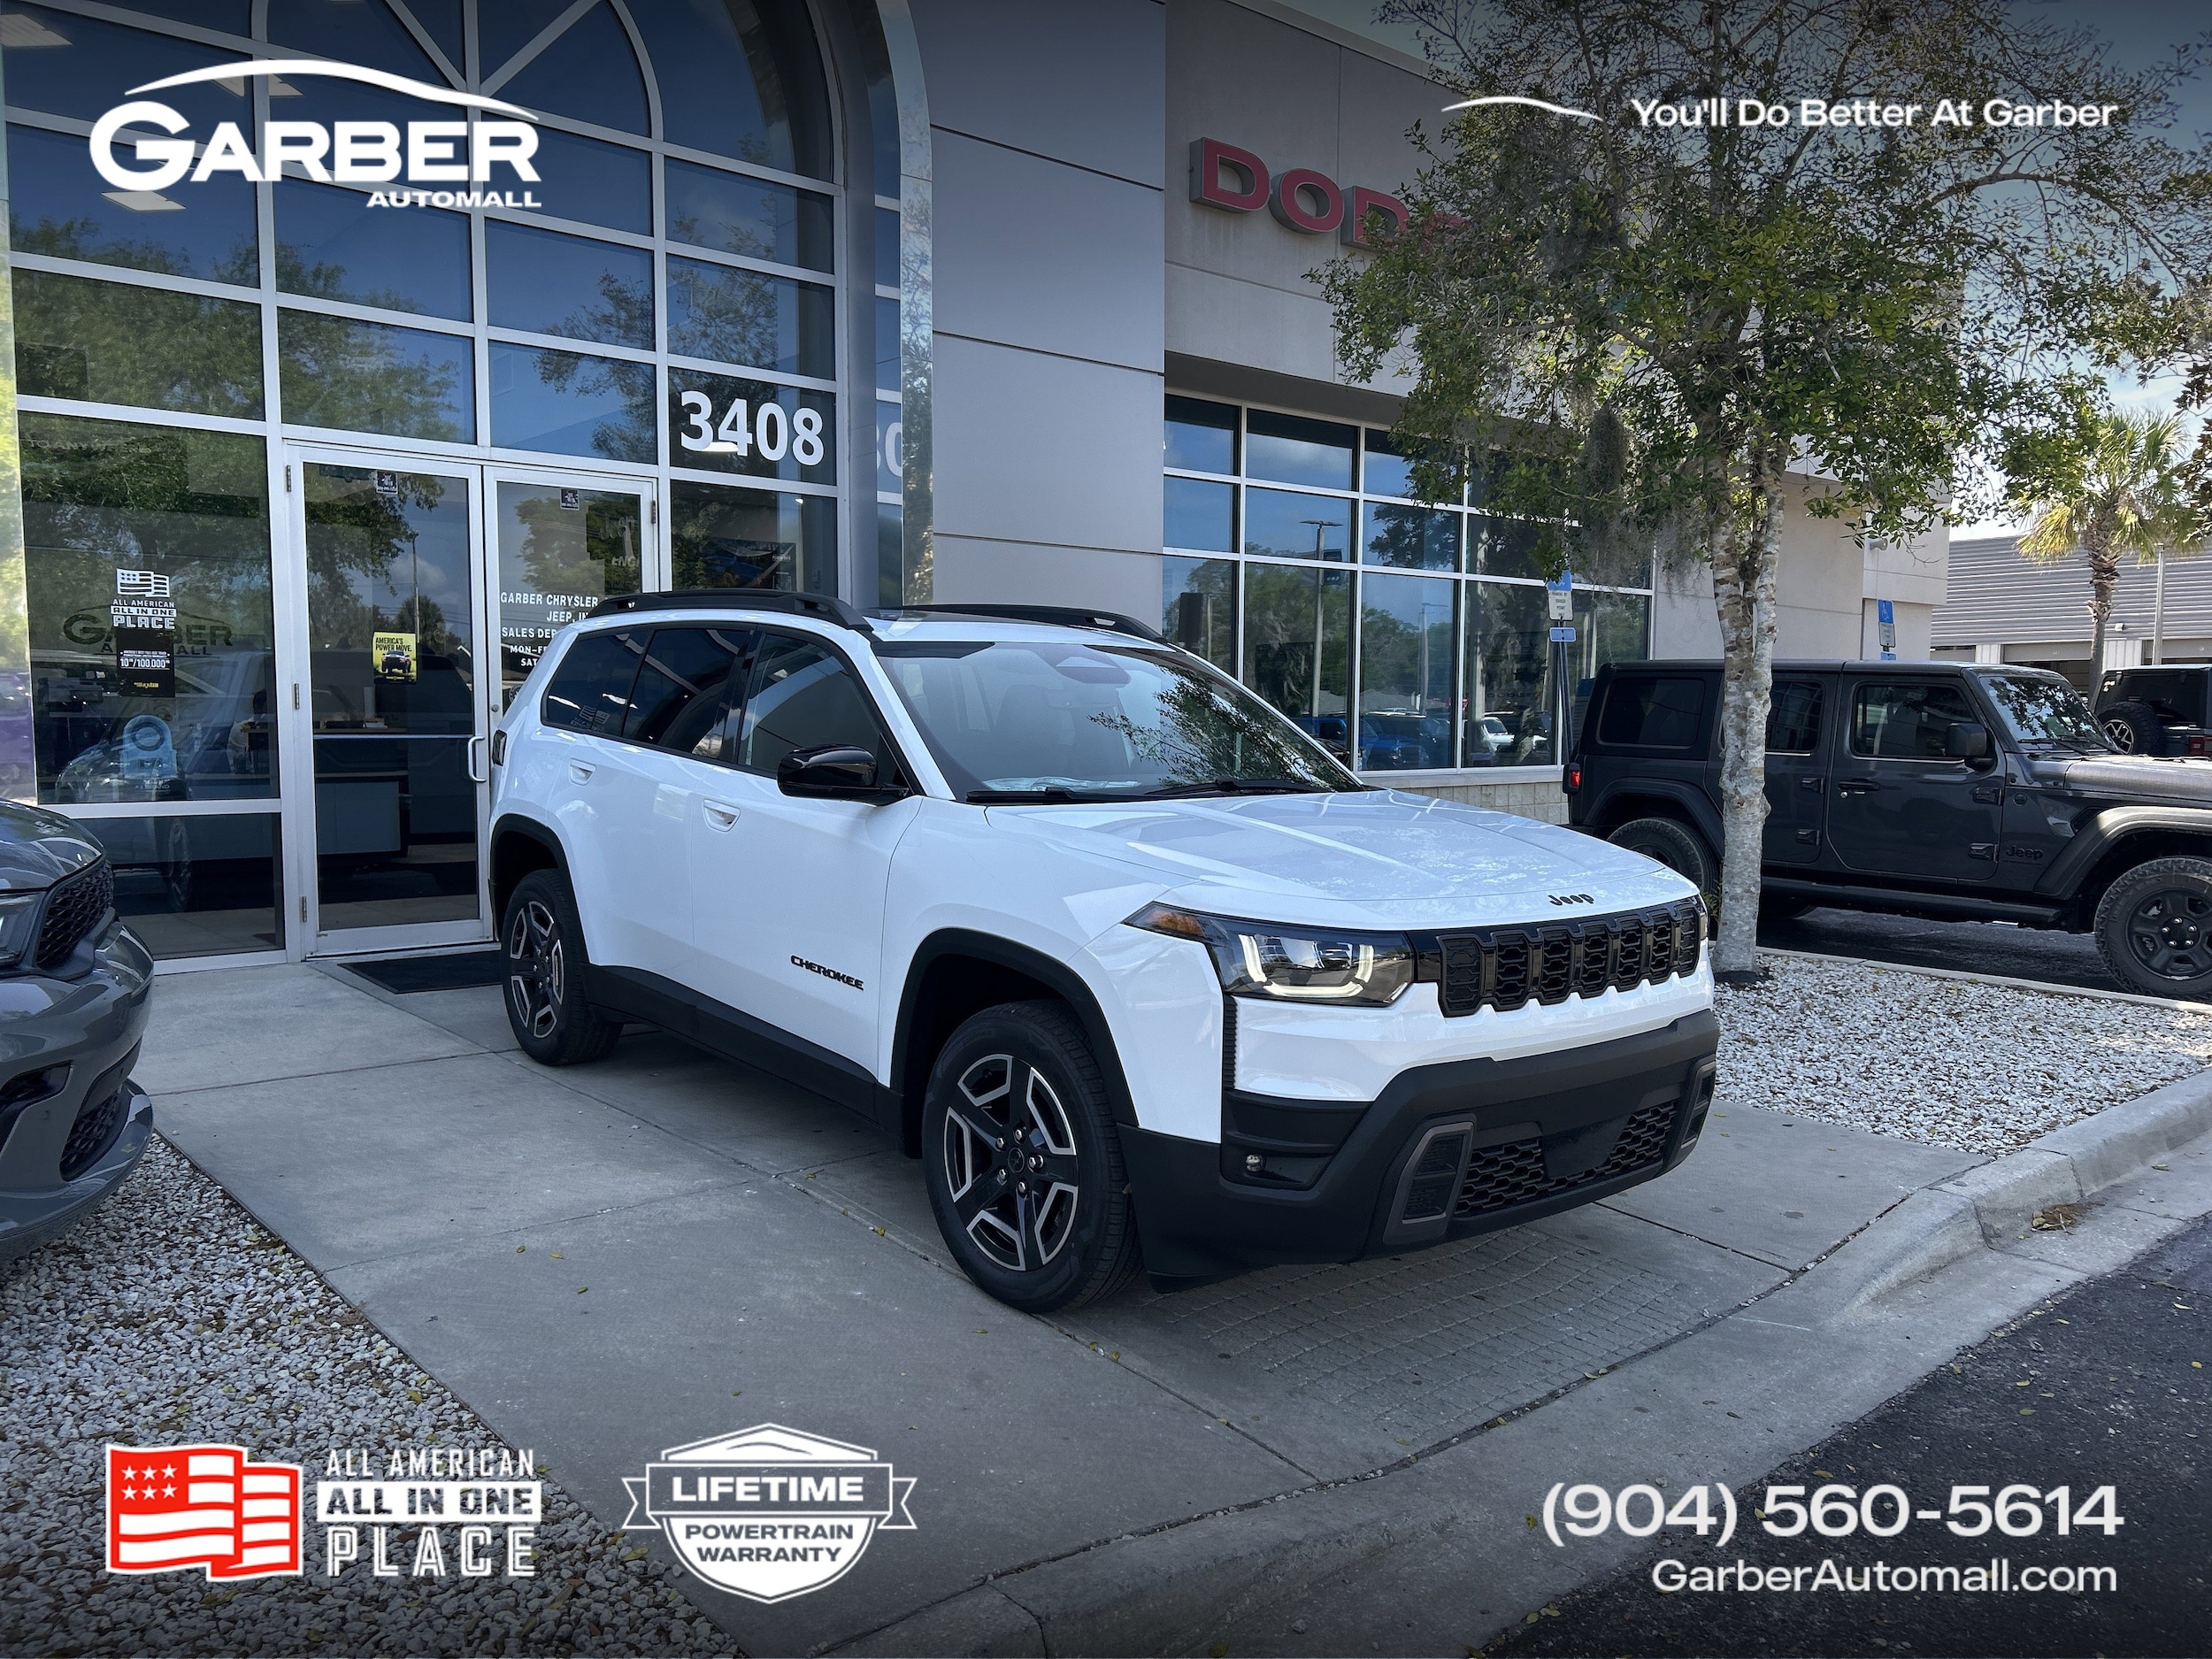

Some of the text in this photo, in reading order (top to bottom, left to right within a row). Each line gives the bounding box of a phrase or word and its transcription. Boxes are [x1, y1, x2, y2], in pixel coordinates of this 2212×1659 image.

[680, 390, 824, 466] 3408
[501, 592, 598, 607] GARBER CHRYSLER
[113, 615, 175, 629] PLACE
[546, 611, 575, 623] JEEP,
[501, 626, 535, 638] SALES
[2006, 844, 2043, 860] Jeep
[1548, 894, 1594, 906] Jeep
[790, 955, 864, 991] CHEROKEE
